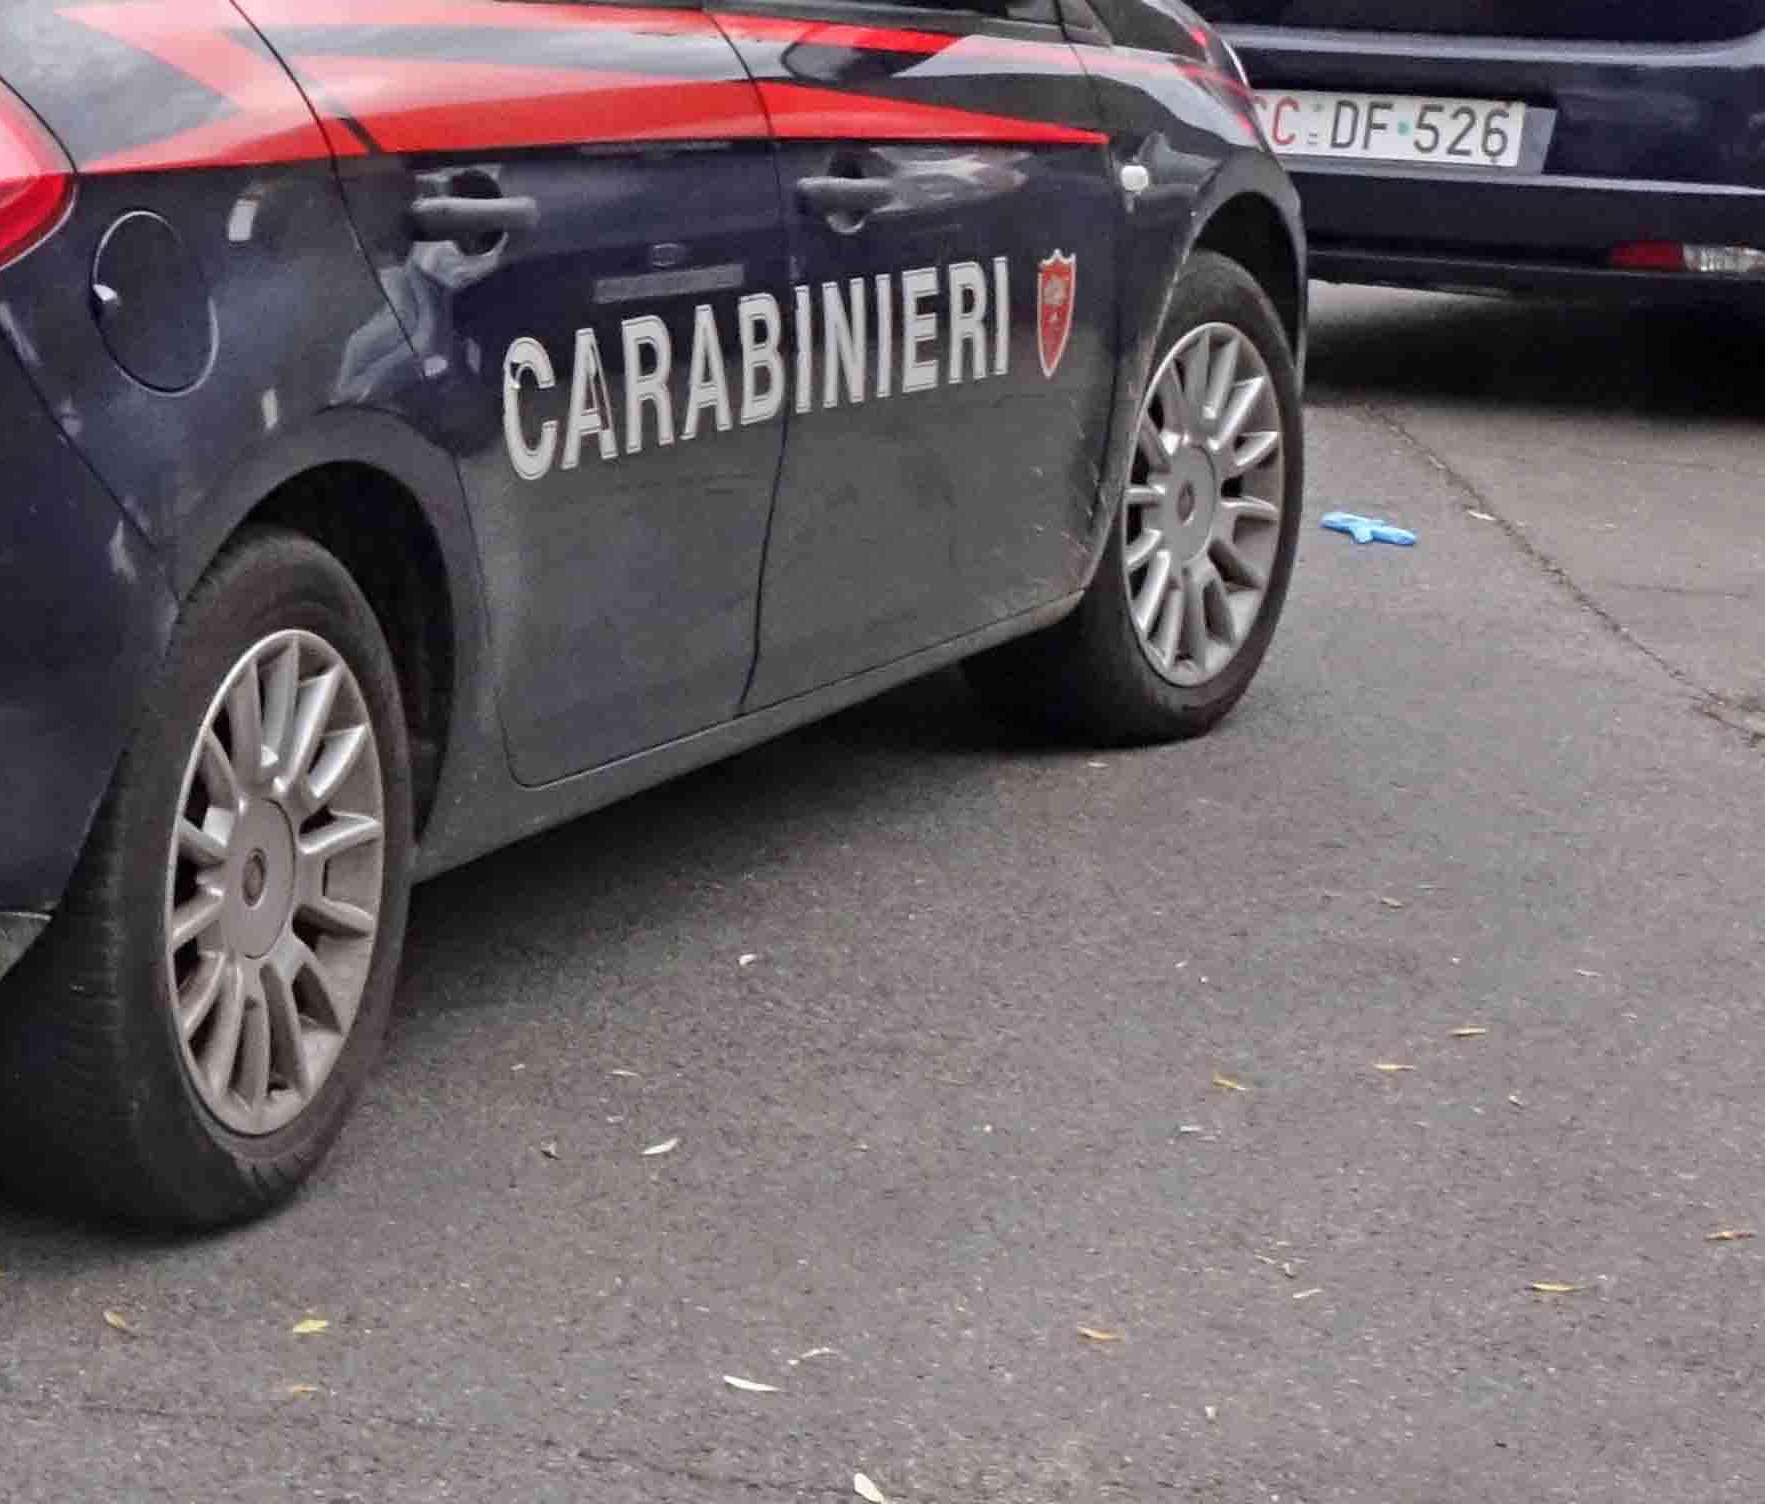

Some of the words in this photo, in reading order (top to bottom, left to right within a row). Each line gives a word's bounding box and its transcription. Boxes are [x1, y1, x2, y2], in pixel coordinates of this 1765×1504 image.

[1330, 101, 1394, 151] DF
[1412, 103, 1510, 158] 526
[502, 255, 1009, 481] CARABINIERI
